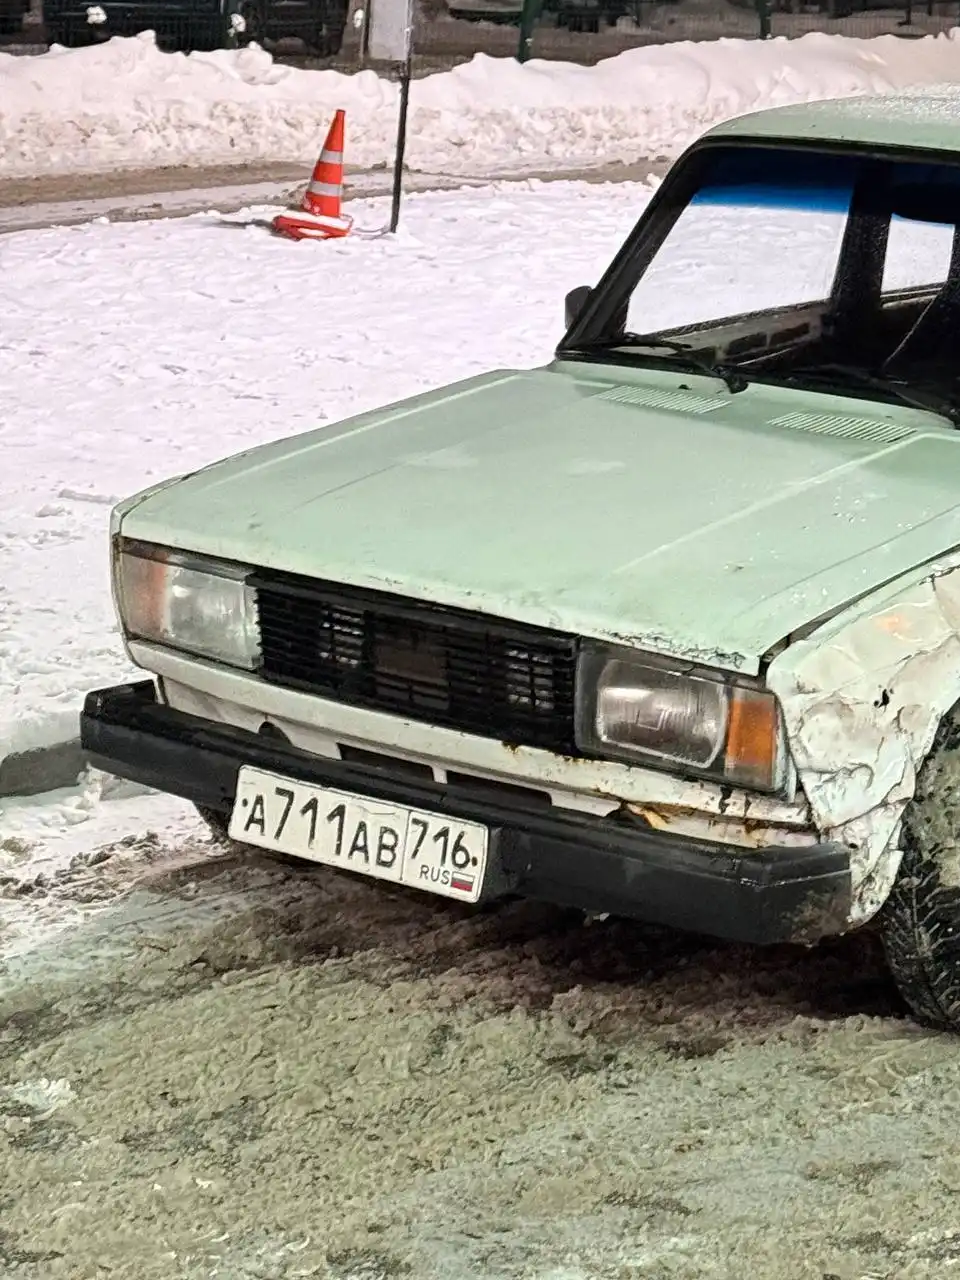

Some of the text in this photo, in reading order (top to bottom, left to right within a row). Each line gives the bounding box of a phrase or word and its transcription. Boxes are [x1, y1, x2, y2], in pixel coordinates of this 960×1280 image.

[243, 786, 471, 869] А711АВ 716
[418, 864, 450, 886] RUS
